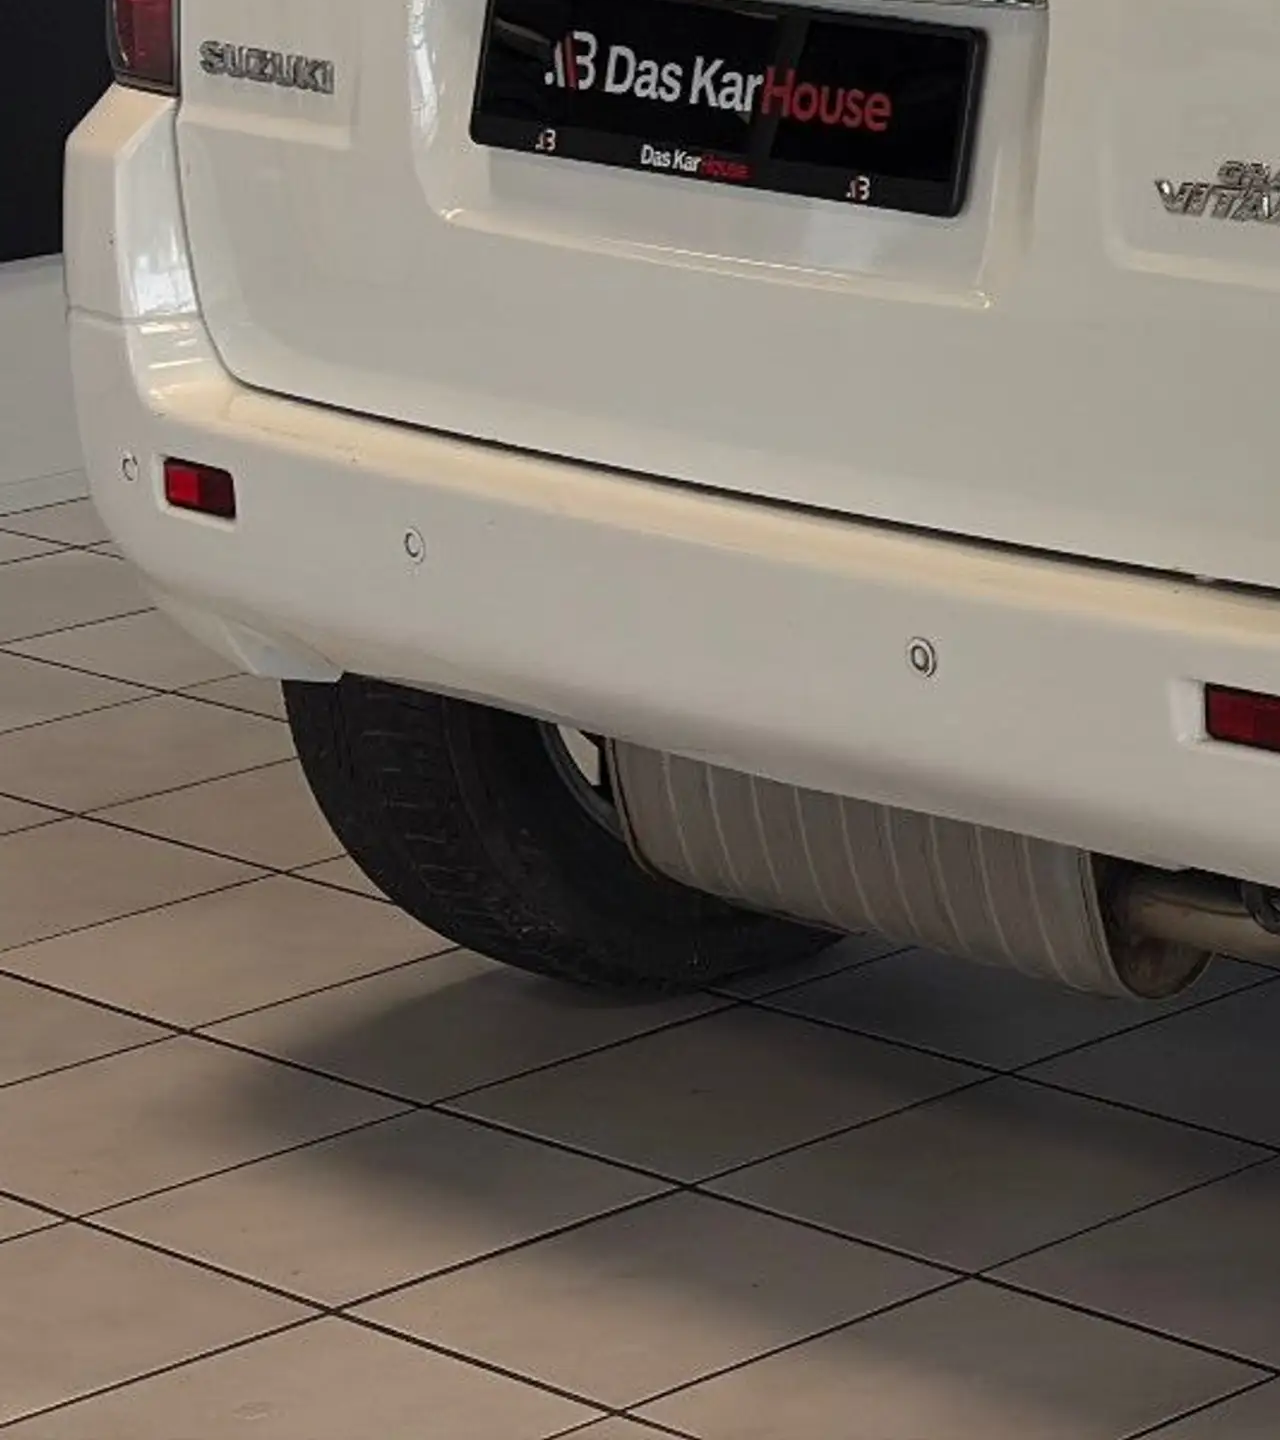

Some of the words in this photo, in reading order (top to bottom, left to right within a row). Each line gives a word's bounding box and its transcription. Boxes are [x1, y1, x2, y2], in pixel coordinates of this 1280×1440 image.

[199, 40, 335, 94] SUZUKI
[604, 45, 683, 102] Das
[689, 56, 892, 132] KarHouse
[640, 144, 671, 167] Das
